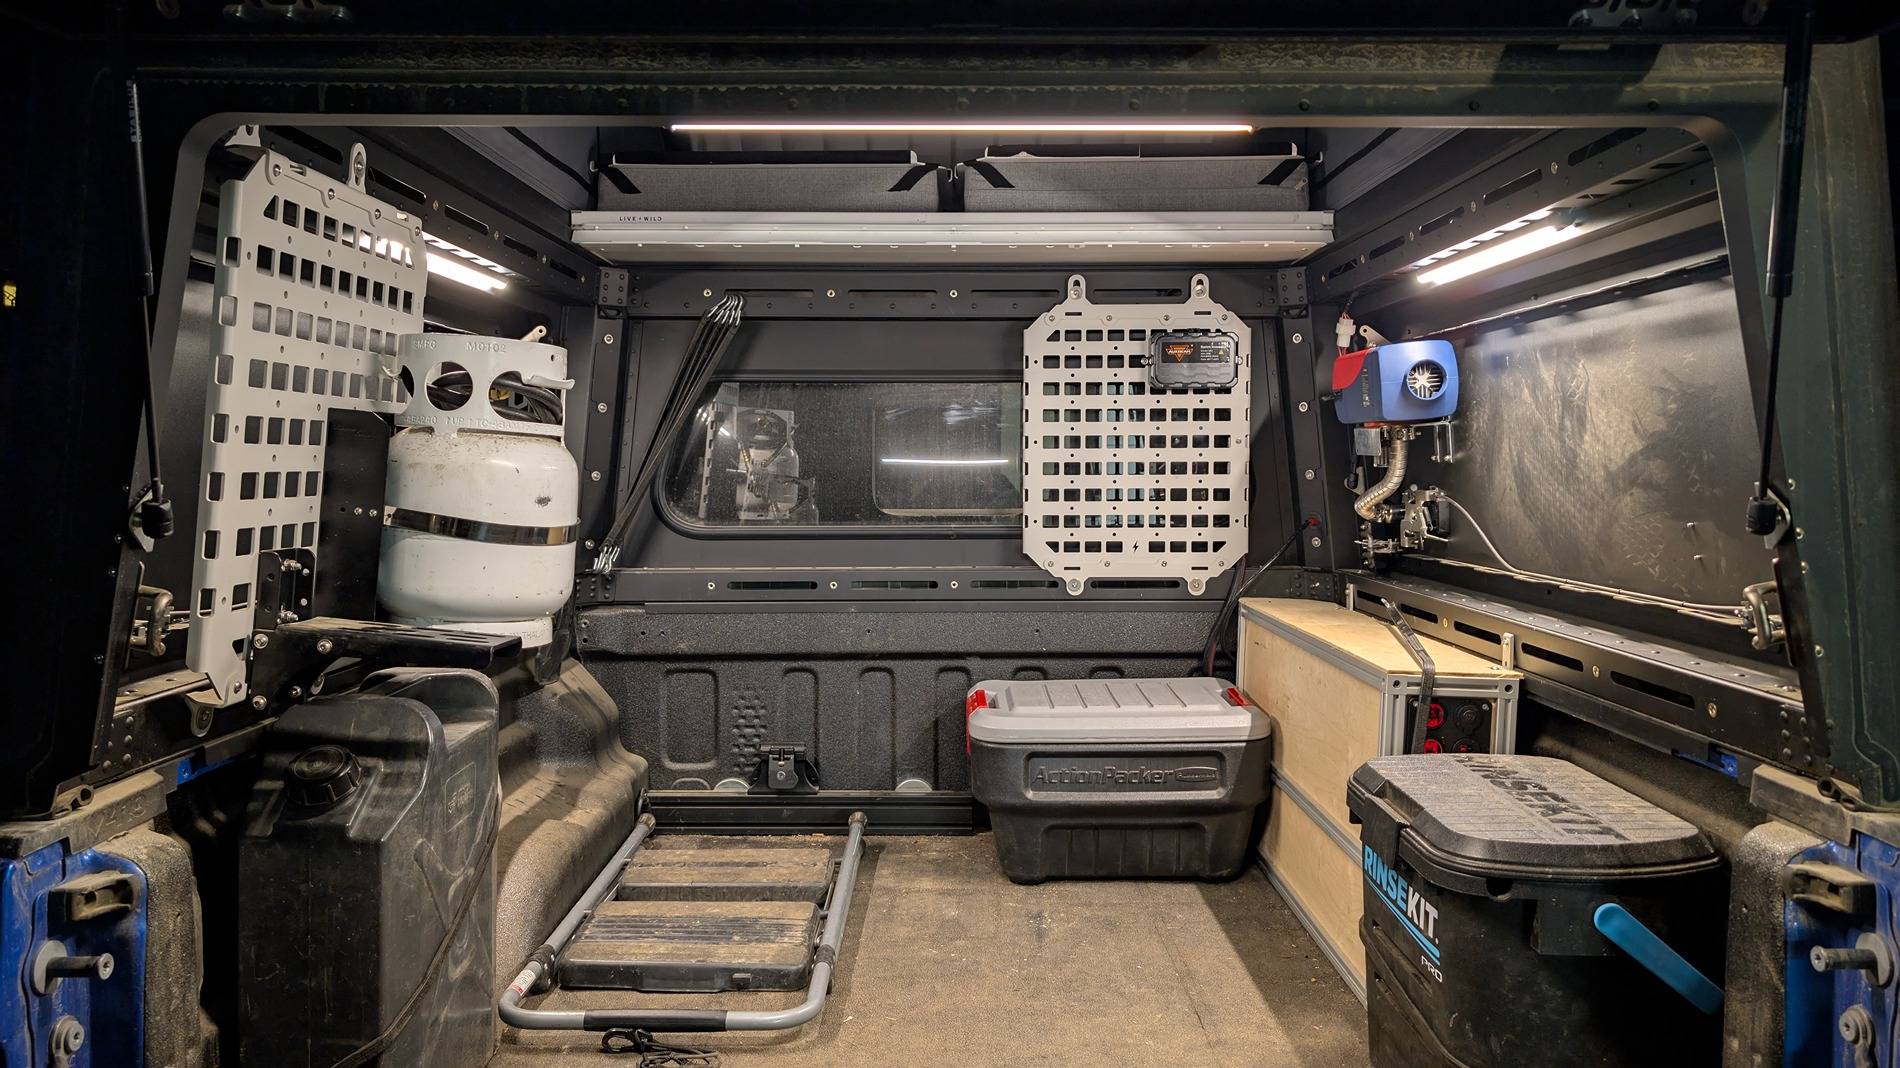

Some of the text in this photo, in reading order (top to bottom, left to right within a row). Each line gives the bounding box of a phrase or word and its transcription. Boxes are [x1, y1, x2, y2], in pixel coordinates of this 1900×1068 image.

[1032, 765, 1175, 785] ActionPacker
[1363, 844, 1439, 939] RINSEKIT
[1421, 955, 1443, 983] PRO
